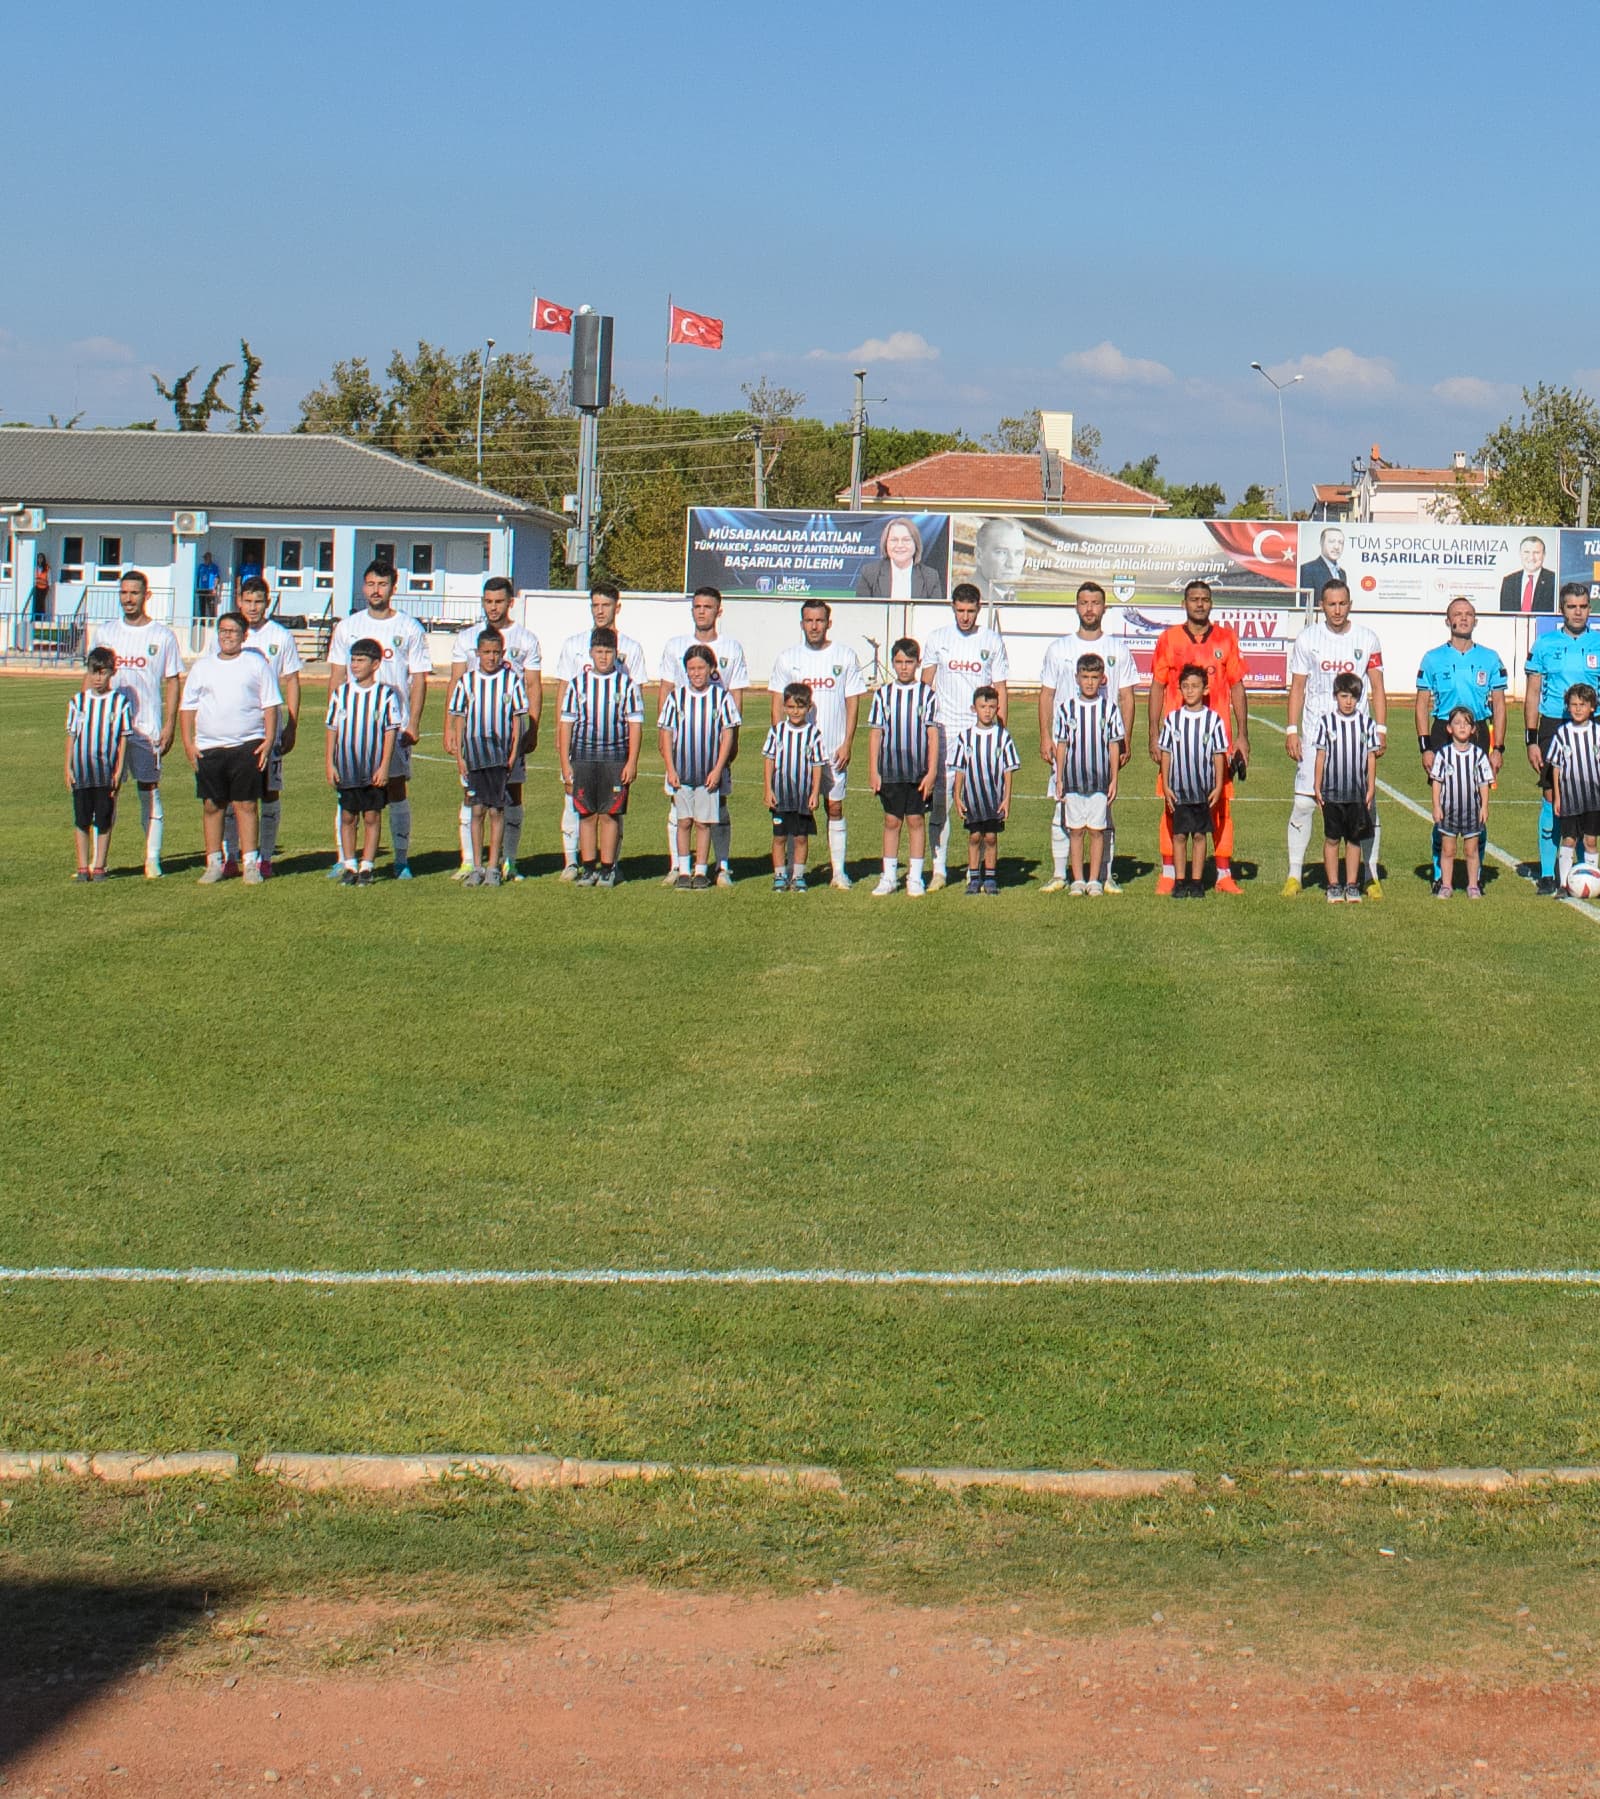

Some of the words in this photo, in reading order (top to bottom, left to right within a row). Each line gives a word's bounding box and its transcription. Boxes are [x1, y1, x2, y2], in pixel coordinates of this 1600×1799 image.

[709, 526, 807, 542] MÜSABAKALARA
[809, 531, 861, 543] KATILAN
[694, 540, 714, 551] TÜM
[753, 544, 791, 554] SPORCU
[792, 544, 803, 553] VE
[802, 544, 875, 555] ANTRENÖRLERE
[1080, 541, 1144, 556] Sporcunun
[1349, 535, 1381, 549] TÜM
[1384, 537, 1509, 552] SPORCULARIMIZA
[724, 555, 792, 570] BAŞARILAR
[793, 556, 844, 570] DİLERİM
[1024, 557, 1051, 571] Aynı
[1053, 558, 1111, 570] Zamanda
[1113, 558, 1175, 572] Ahlaklısını
[1361, 552, 1439, 566] BAŞARILAR
[1443, 552, 1497, 566] DİLERİZ
[1221, 608, 1279, 620] DİDİM
